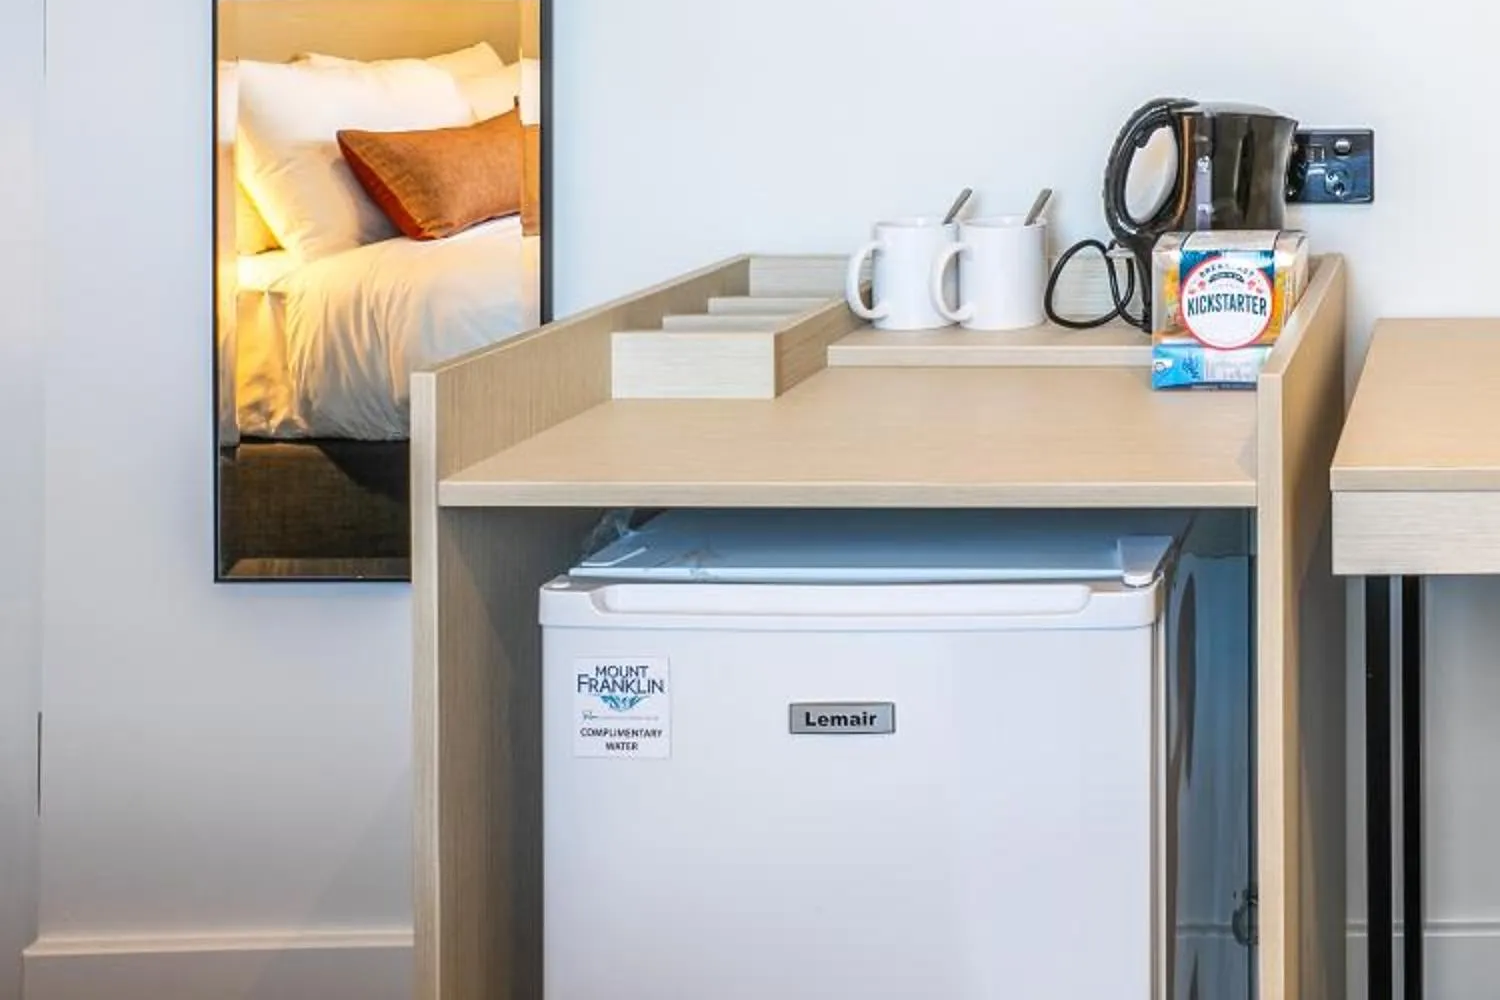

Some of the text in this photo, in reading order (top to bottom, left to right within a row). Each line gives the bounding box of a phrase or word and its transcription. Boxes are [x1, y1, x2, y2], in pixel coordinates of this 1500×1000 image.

[1187, 293, 1267, 317] KICKSTARTER
[595, 665, 649, 678] MOUNT
[577, 673, 665, 694] FRANKLIN
[805, 711, 877, 727] Lemair
[580, 727, 663, 738] COMPLIMENTARY
[605, 741, 639, 751] WATER
